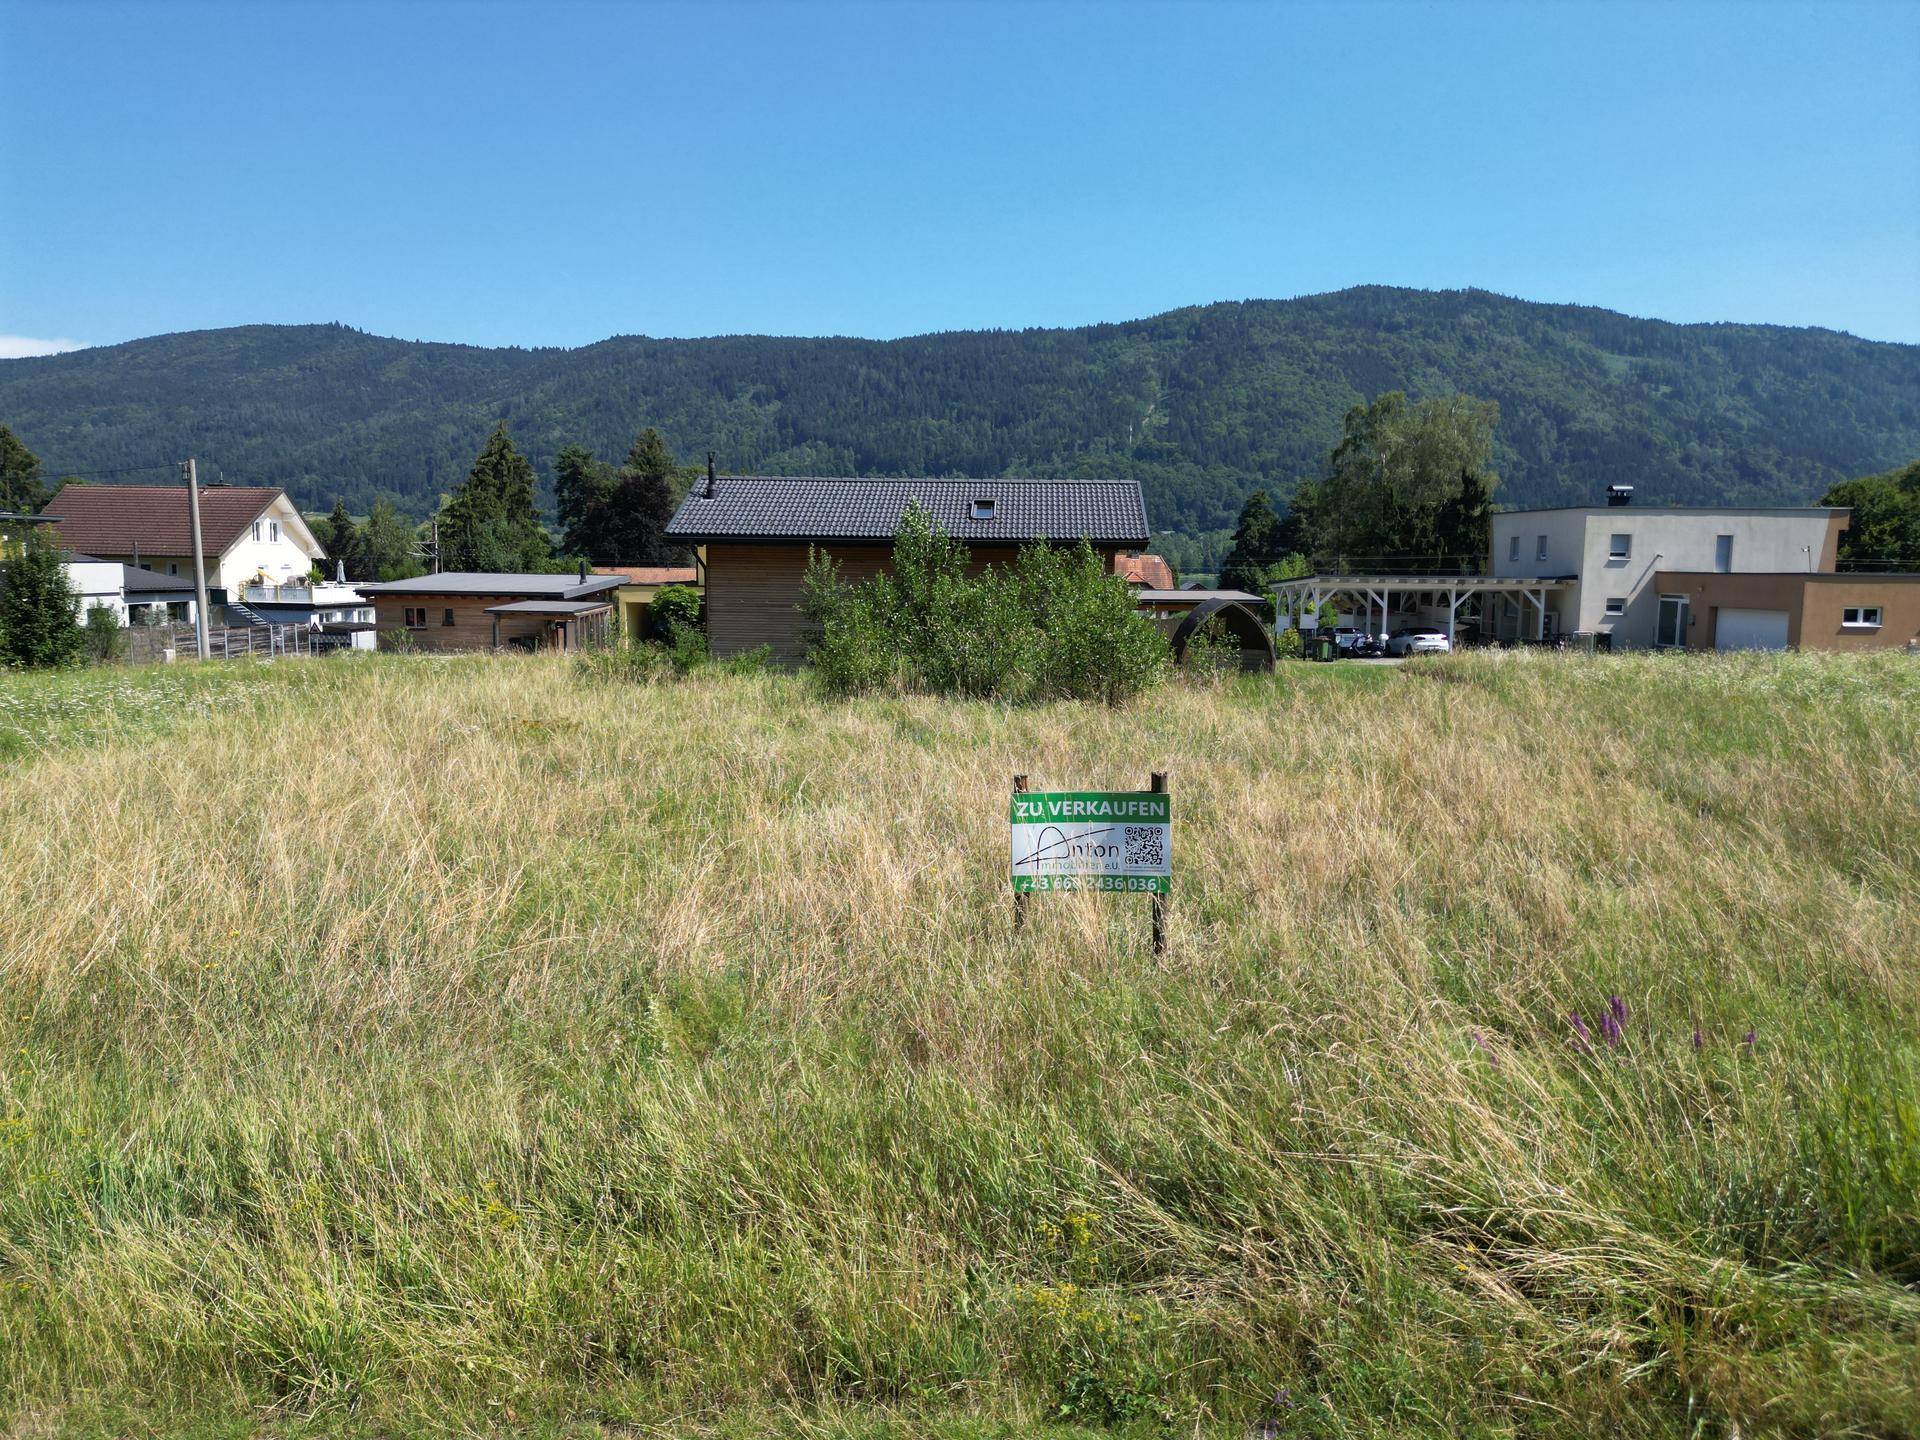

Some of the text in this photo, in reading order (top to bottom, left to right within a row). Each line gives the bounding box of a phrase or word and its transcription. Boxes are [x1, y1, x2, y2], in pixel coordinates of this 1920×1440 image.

[1017, 800, 1165, 816] ZU VERKAUFEN
[1015, 826, 1120, 869] Anton
[1105, 862, 1120, 870] e.U.
[1021, 877, 1049, 890] +43
[1128, 878, 1157, 891] 036
